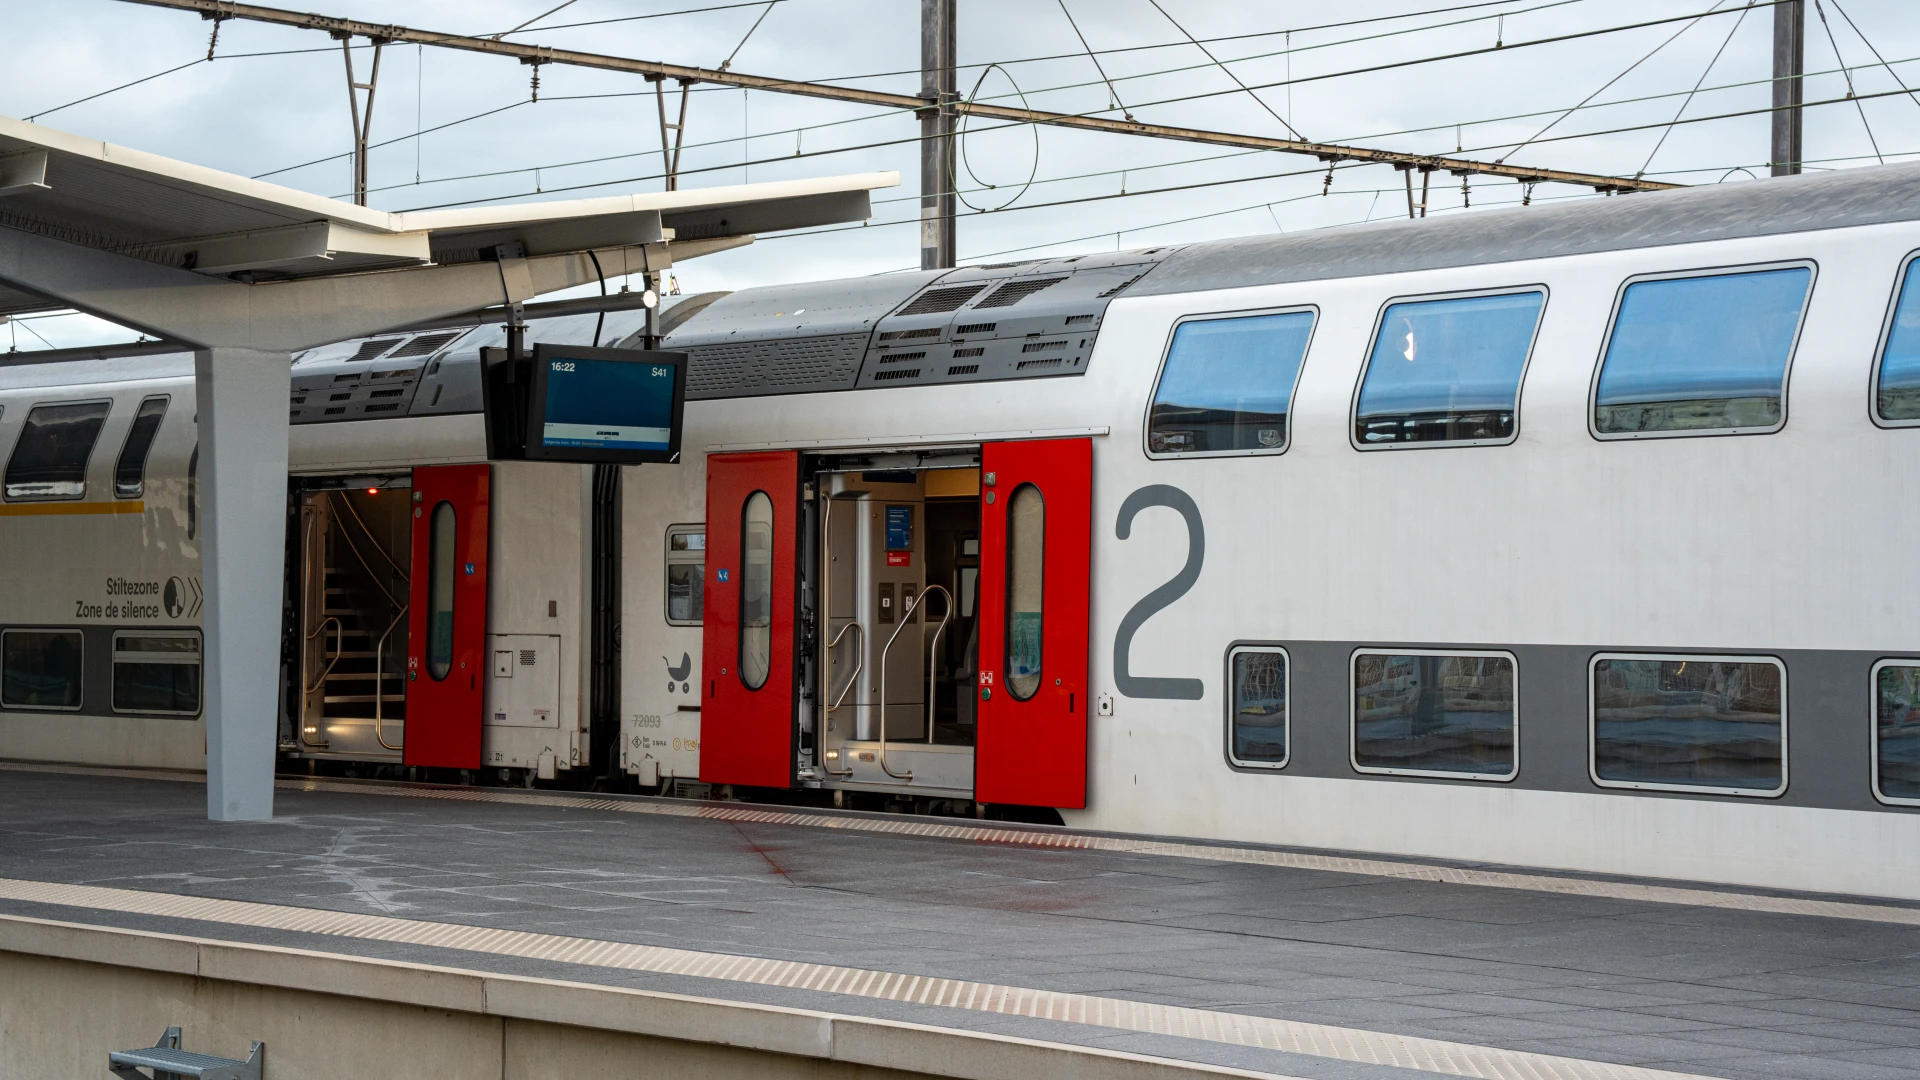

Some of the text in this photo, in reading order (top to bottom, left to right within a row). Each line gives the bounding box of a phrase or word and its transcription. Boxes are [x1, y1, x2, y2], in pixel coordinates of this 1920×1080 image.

[551, 361, 575, 372] 16:22
[651, 366, 667, 377] S41
[106, 577, 159, 595] Stiltezone
[1112, 483, 1206, 701] 2
[76, 600, 159, 618] Zone de silence
[632, 714, 661, 728] 72093
[572, 748, 578, 761] 2
[622, 751, 627, 765] 1
